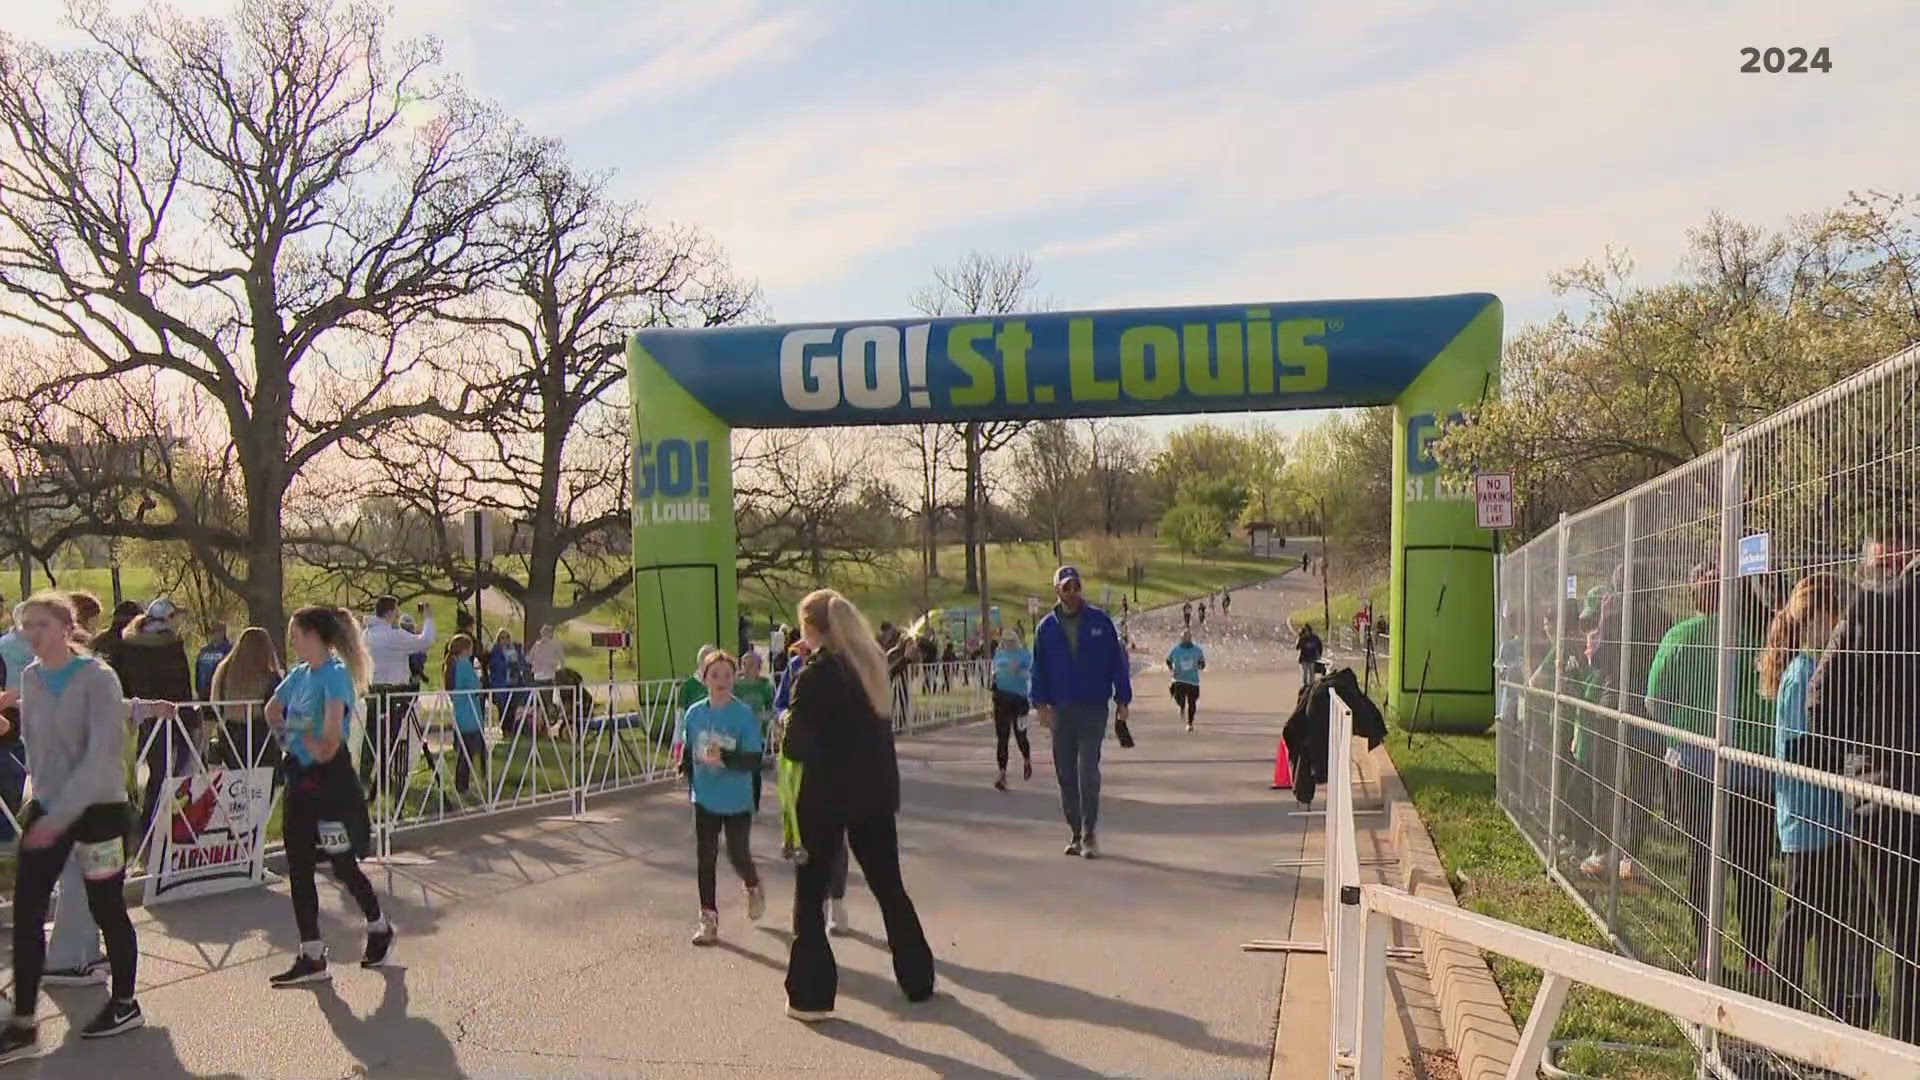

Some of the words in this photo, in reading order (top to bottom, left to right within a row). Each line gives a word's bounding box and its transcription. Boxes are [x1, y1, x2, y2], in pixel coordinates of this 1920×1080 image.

[779, 322, 932, 411] GO!
[947, 320, 1055, 406] St.
[633, 439, 709, 499] GO!
[1487, 479, 1501, 490] NO
[1478, 491, 1511, 503] PARKING
[652, 500, 711, 524] Louis
